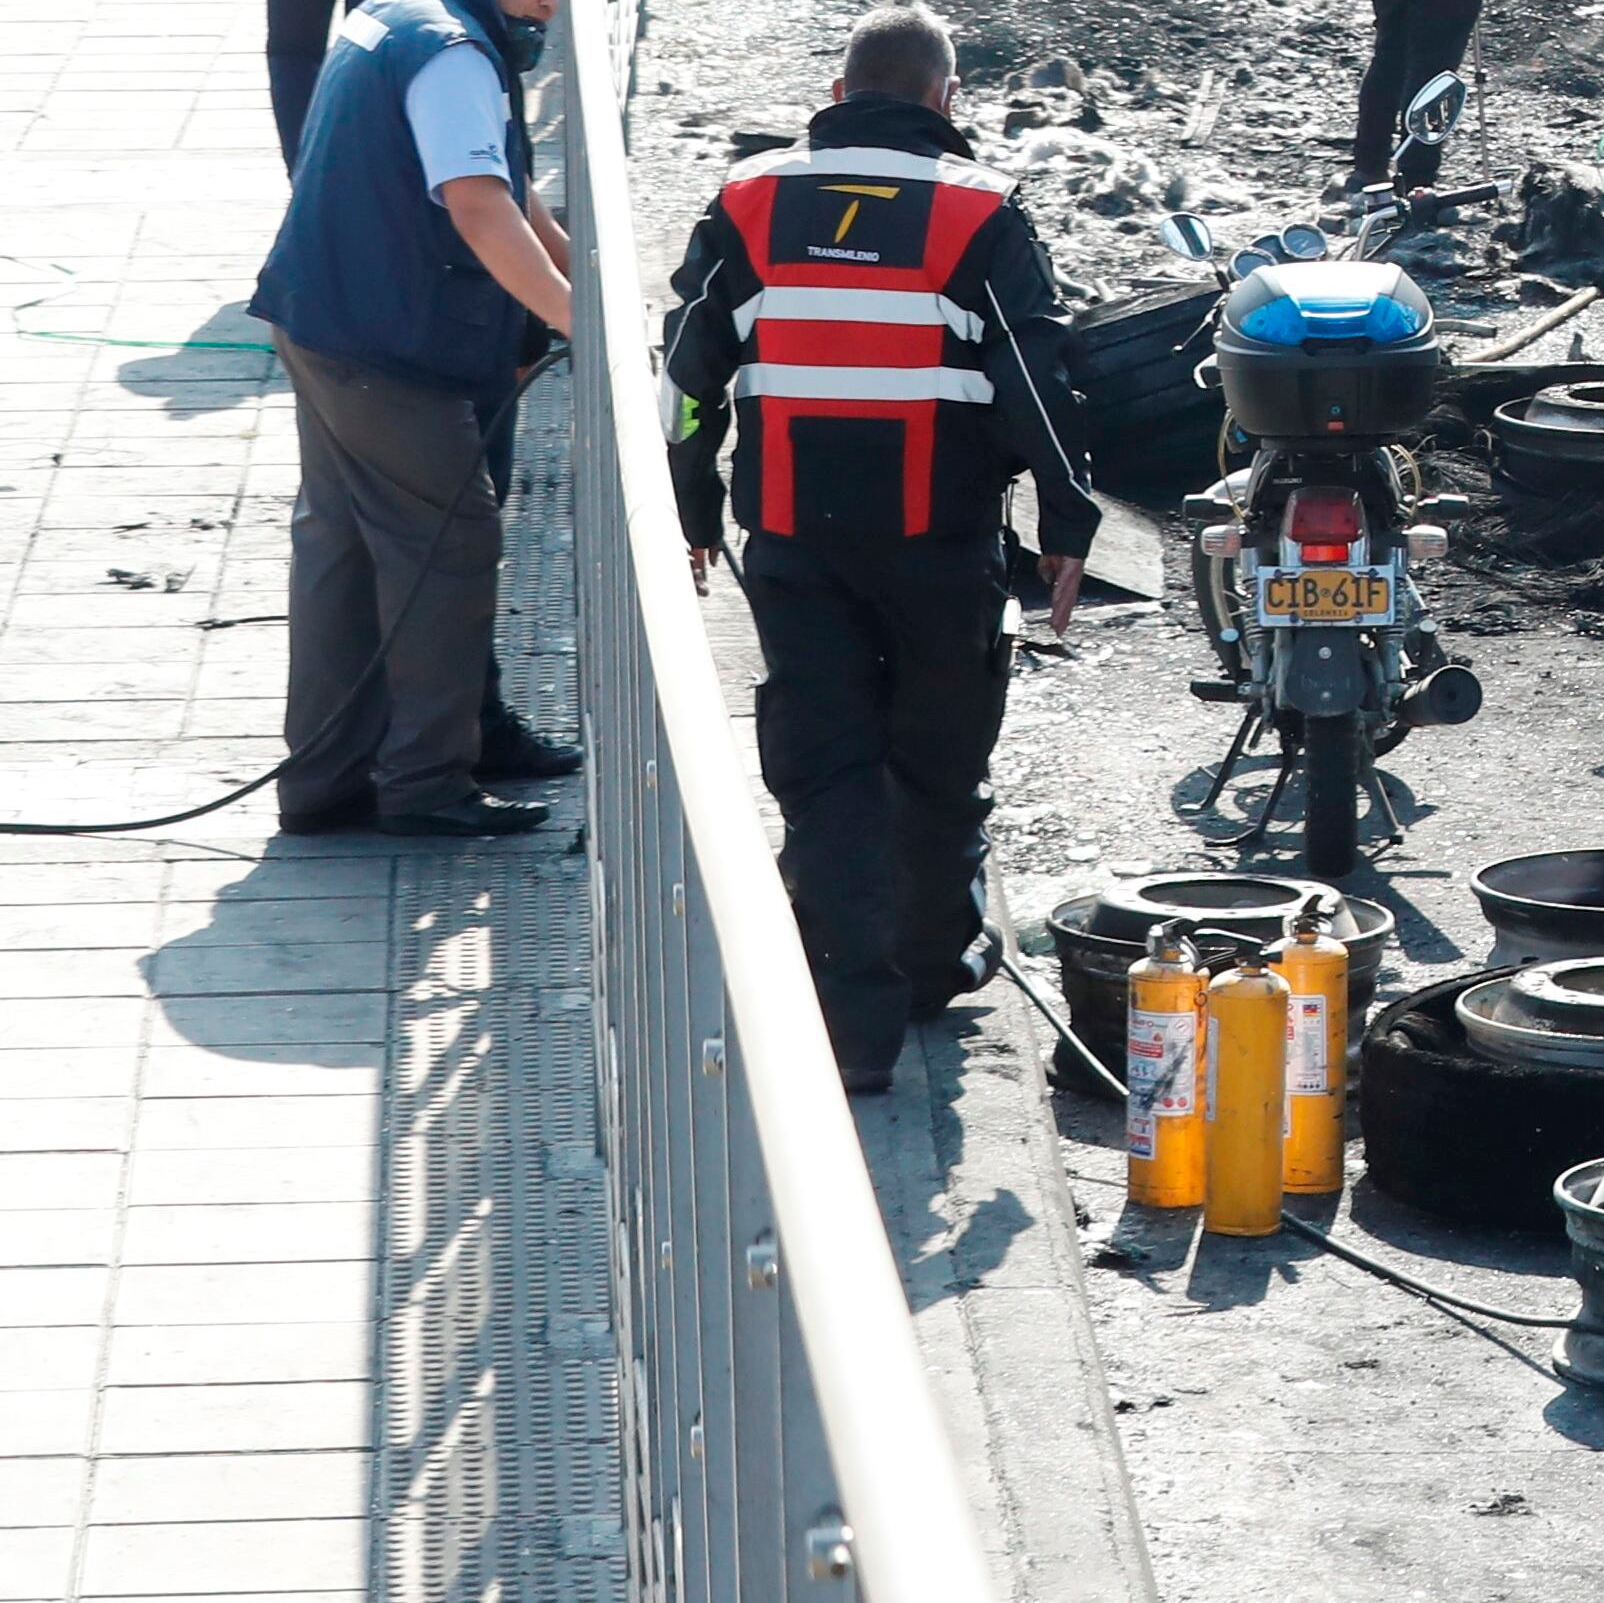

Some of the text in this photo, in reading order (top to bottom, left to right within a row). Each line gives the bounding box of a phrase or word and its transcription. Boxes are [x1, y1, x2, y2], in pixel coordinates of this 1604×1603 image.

[807, 245, 880, 262] TRANSMILENIO
[1267, 577, 1385, 608] CIB 61F
